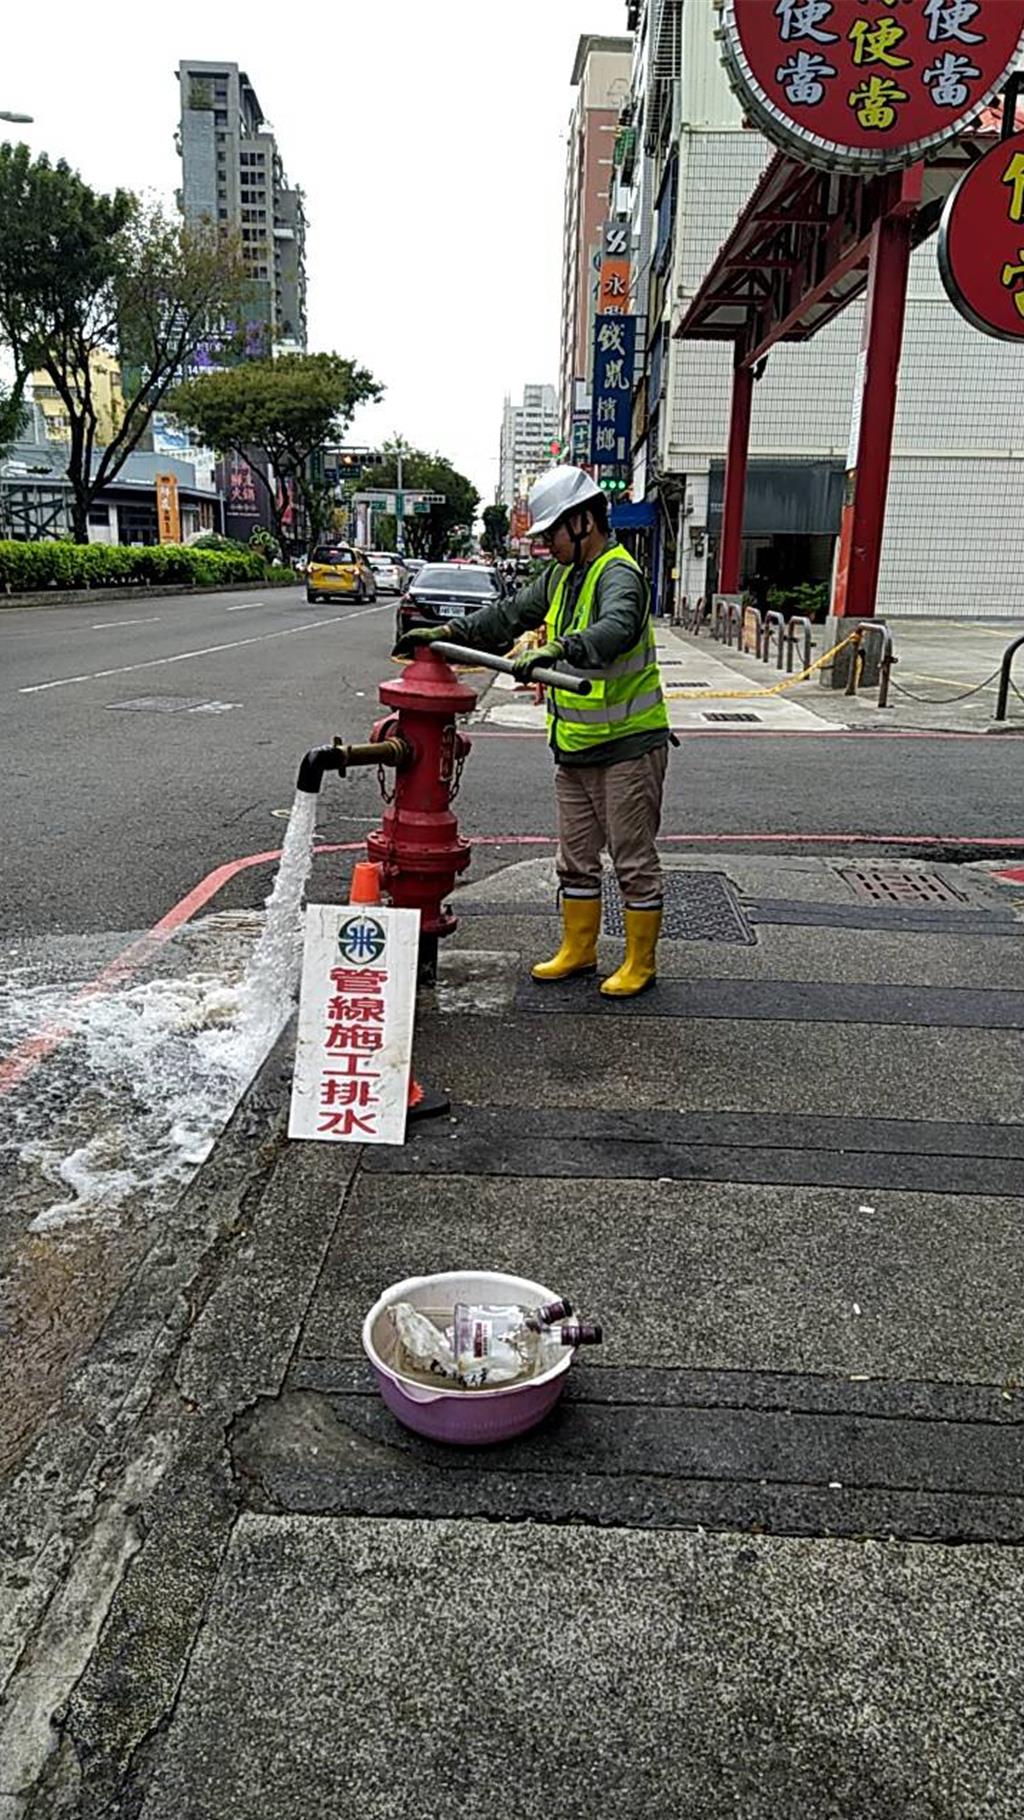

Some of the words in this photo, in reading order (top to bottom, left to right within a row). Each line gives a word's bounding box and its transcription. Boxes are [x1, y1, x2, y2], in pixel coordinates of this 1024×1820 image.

[775, 0, 840, 106] 便當
[847, 0, 912, 132] 便當
[922, 0, 987, 107] 便當
[317, 967, 388, 1136] 管線施工排水
